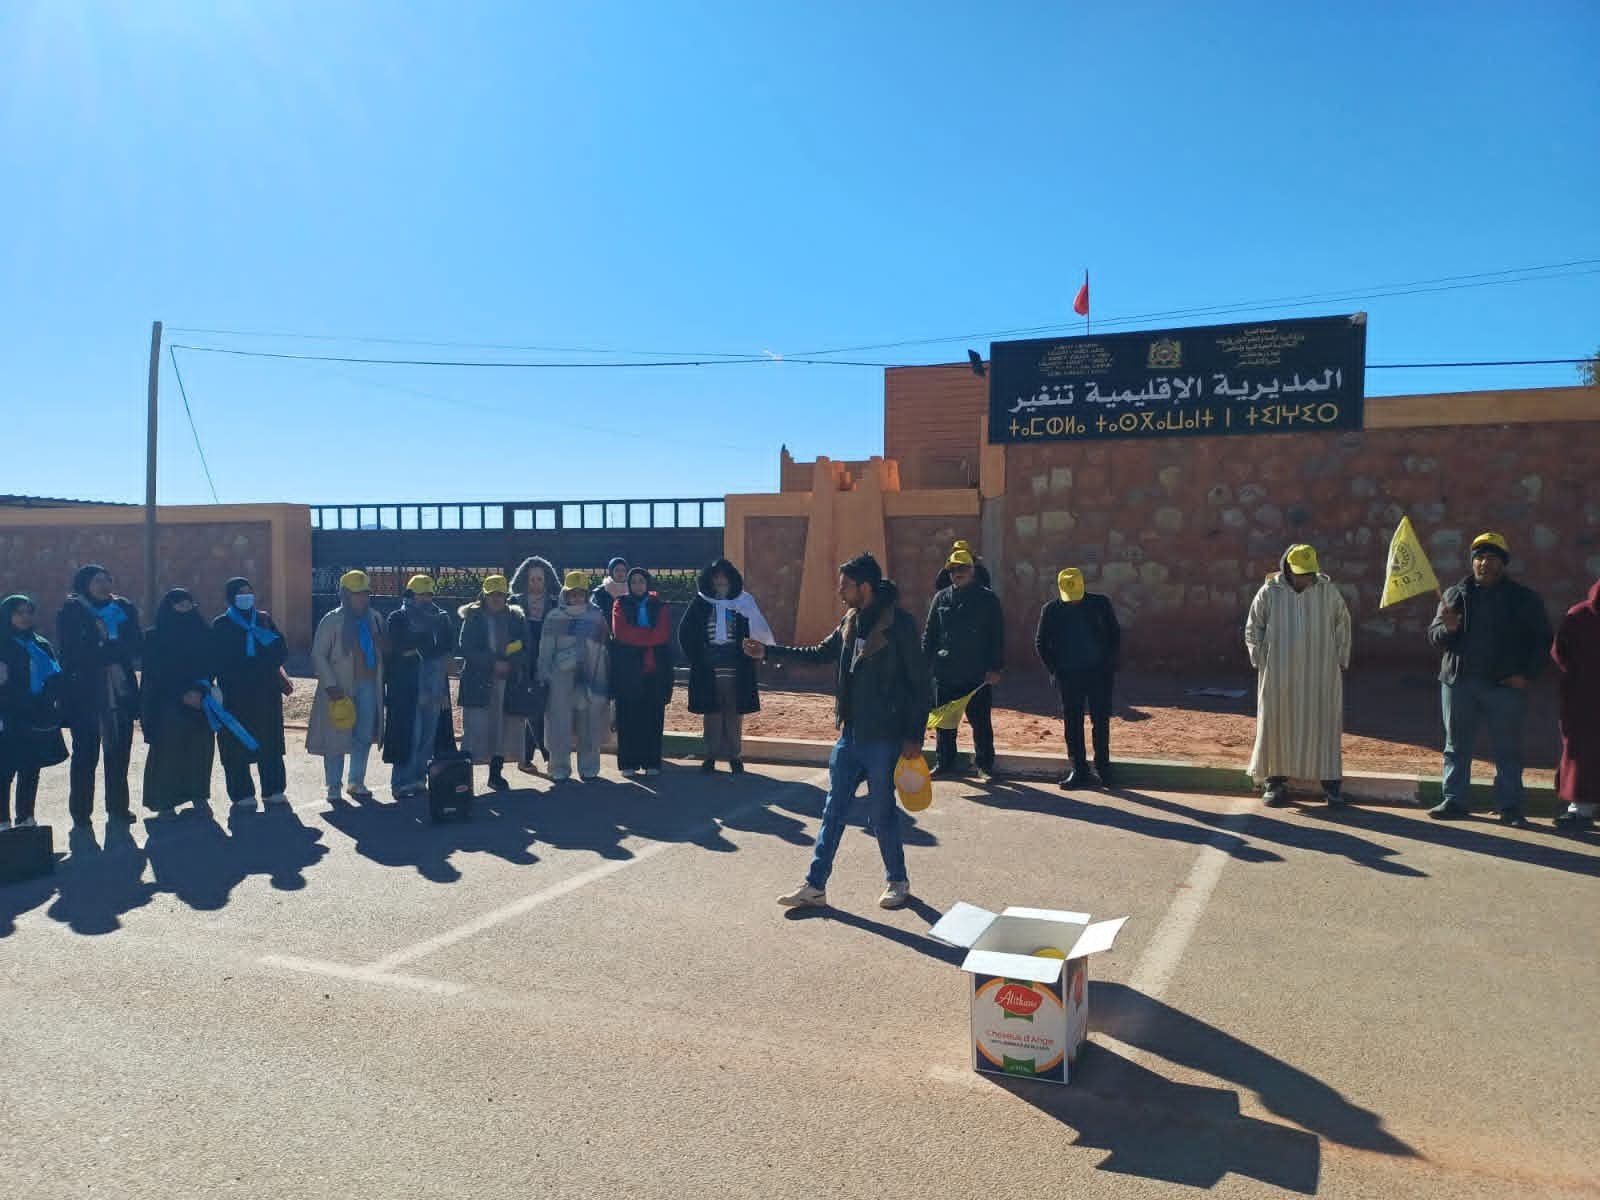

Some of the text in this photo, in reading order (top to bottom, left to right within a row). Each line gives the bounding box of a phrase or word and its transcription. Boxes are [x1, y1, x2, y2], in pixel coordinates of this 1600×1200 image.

[1008, 367, 1343, 413] المديرية الإقليمية تنغير
